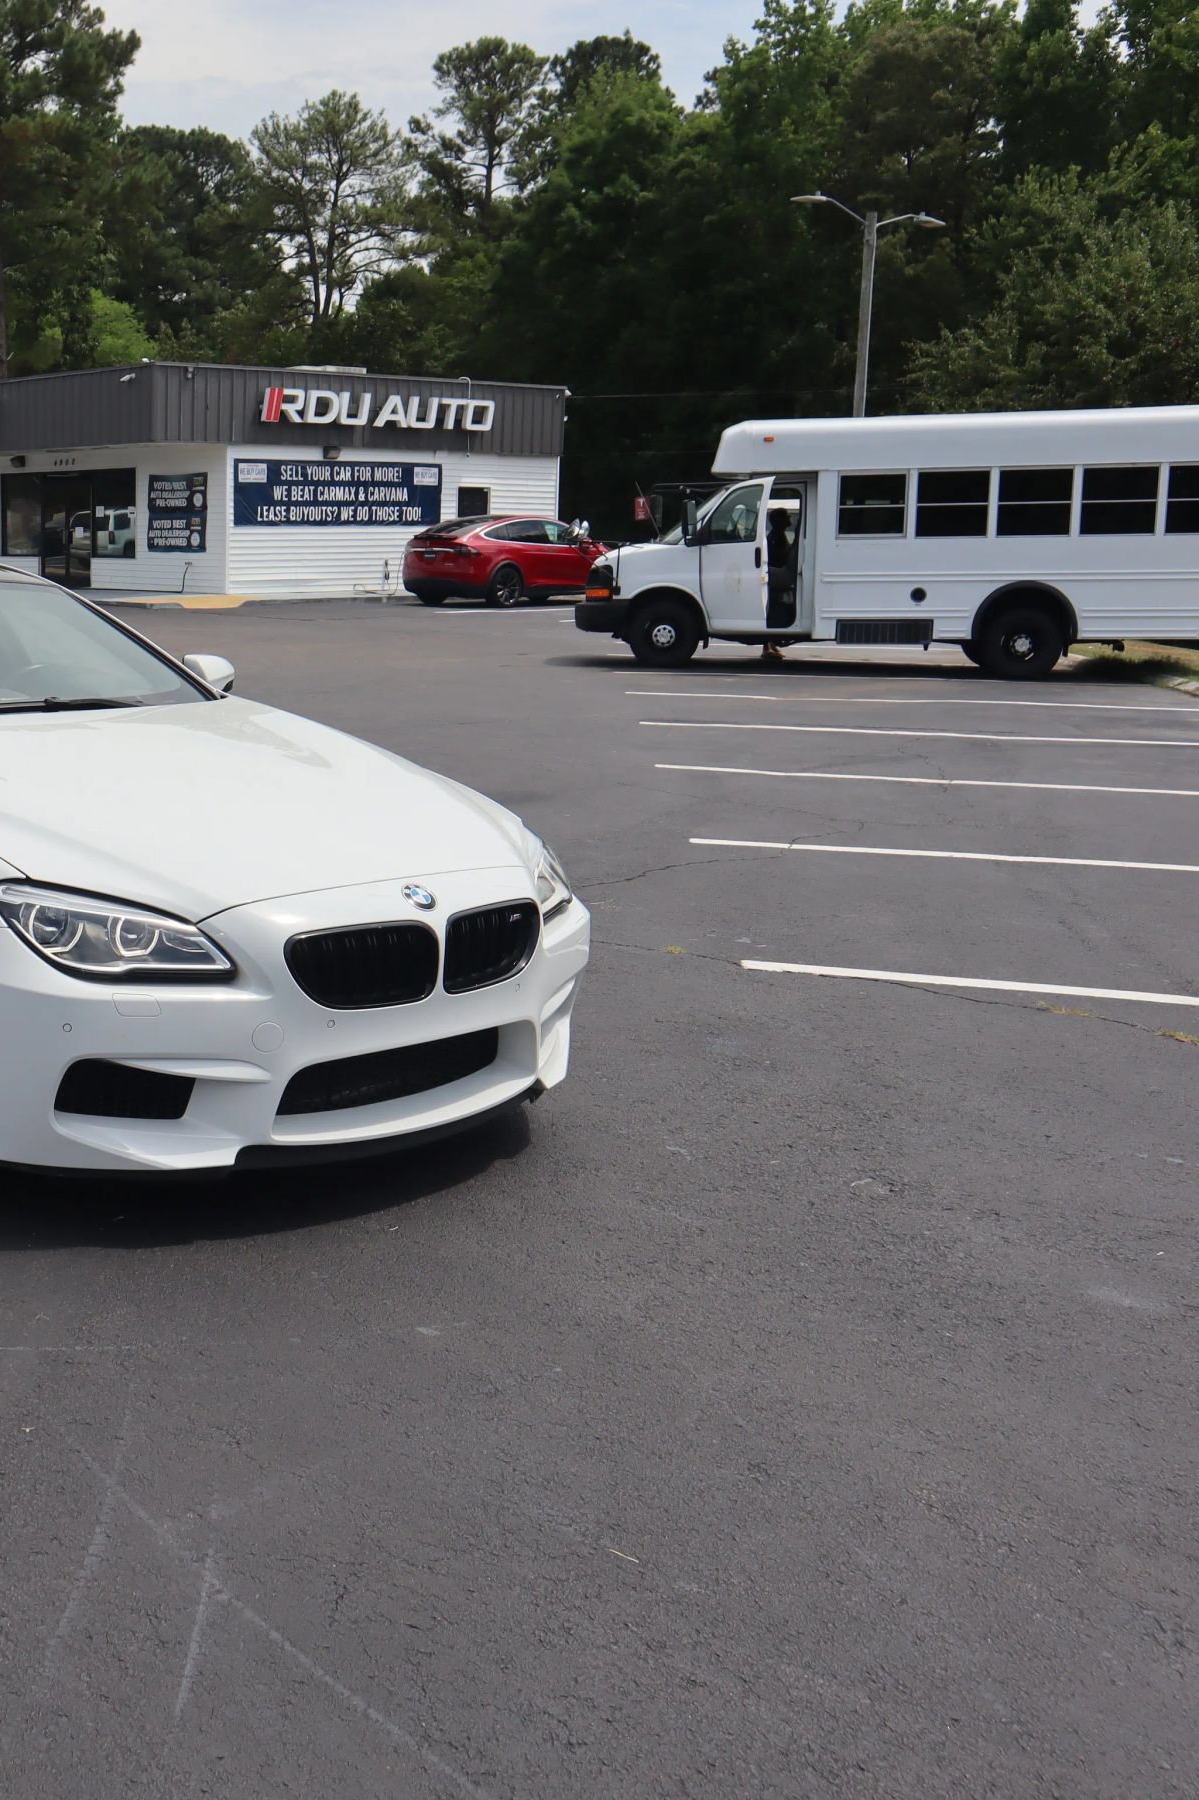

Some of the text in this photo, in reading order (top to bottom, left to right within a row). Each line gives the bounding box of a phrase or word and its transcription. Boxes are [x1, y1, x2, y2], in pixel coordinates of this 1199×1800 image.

[280, 387, 495, 431] RDU AUTO
[280, 465, 402, 482] SELL YOUR CAR FOR MORE!
[273, 485, 409, 502] WE BEAT CARMAX & CARVANA
[257, 505, 422, 521] LEASE BUYOUTS? WE DO THOSE TOO!
[152, 519, 172, 529] VOTED
[172, 519, 187, 529] BEST
[148, 529, 162, 538] AUTO
